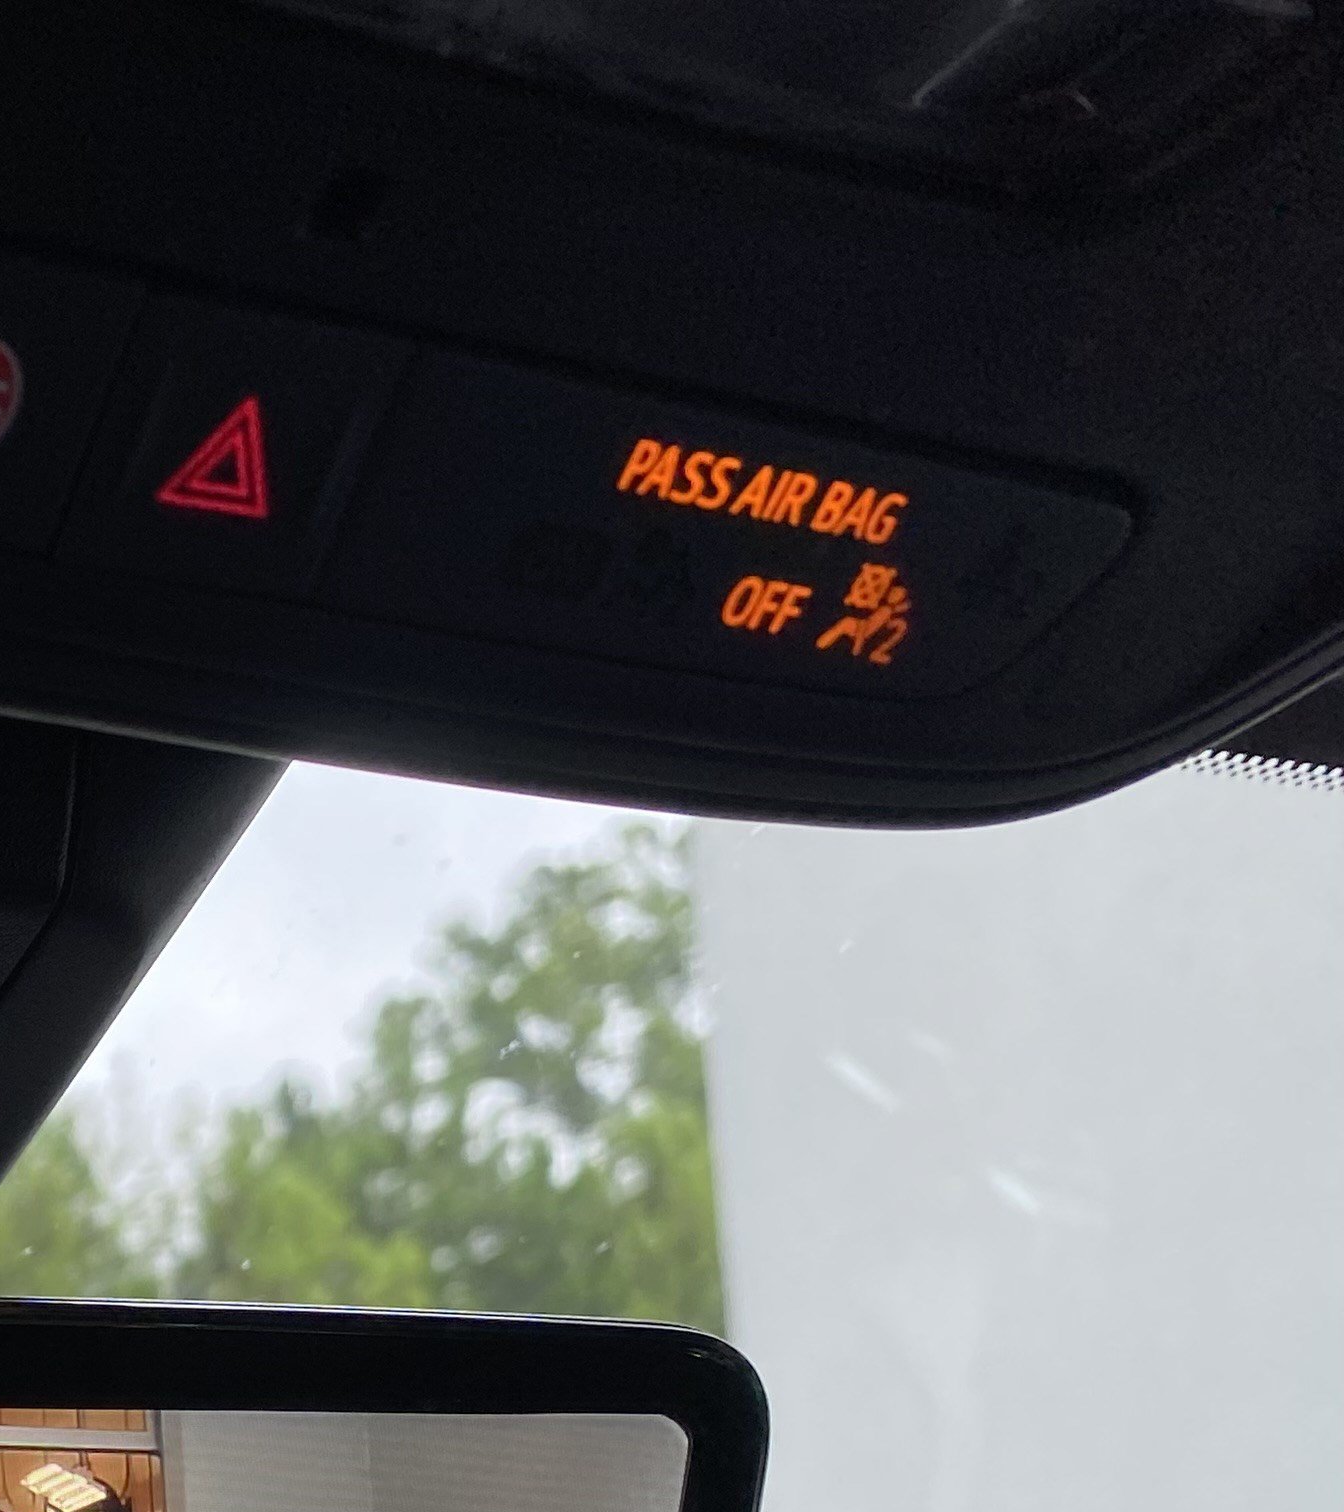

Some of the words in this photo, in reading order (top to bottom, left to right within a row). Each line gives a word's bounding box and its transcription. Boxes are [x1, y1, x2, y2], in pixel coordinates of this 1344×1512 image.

[617, 439, 741, 509] PASS
[730, 466, 817, 525] AIR
[811, 481, 907, 544] BAG
[722, 575, 811, 633] OFF
